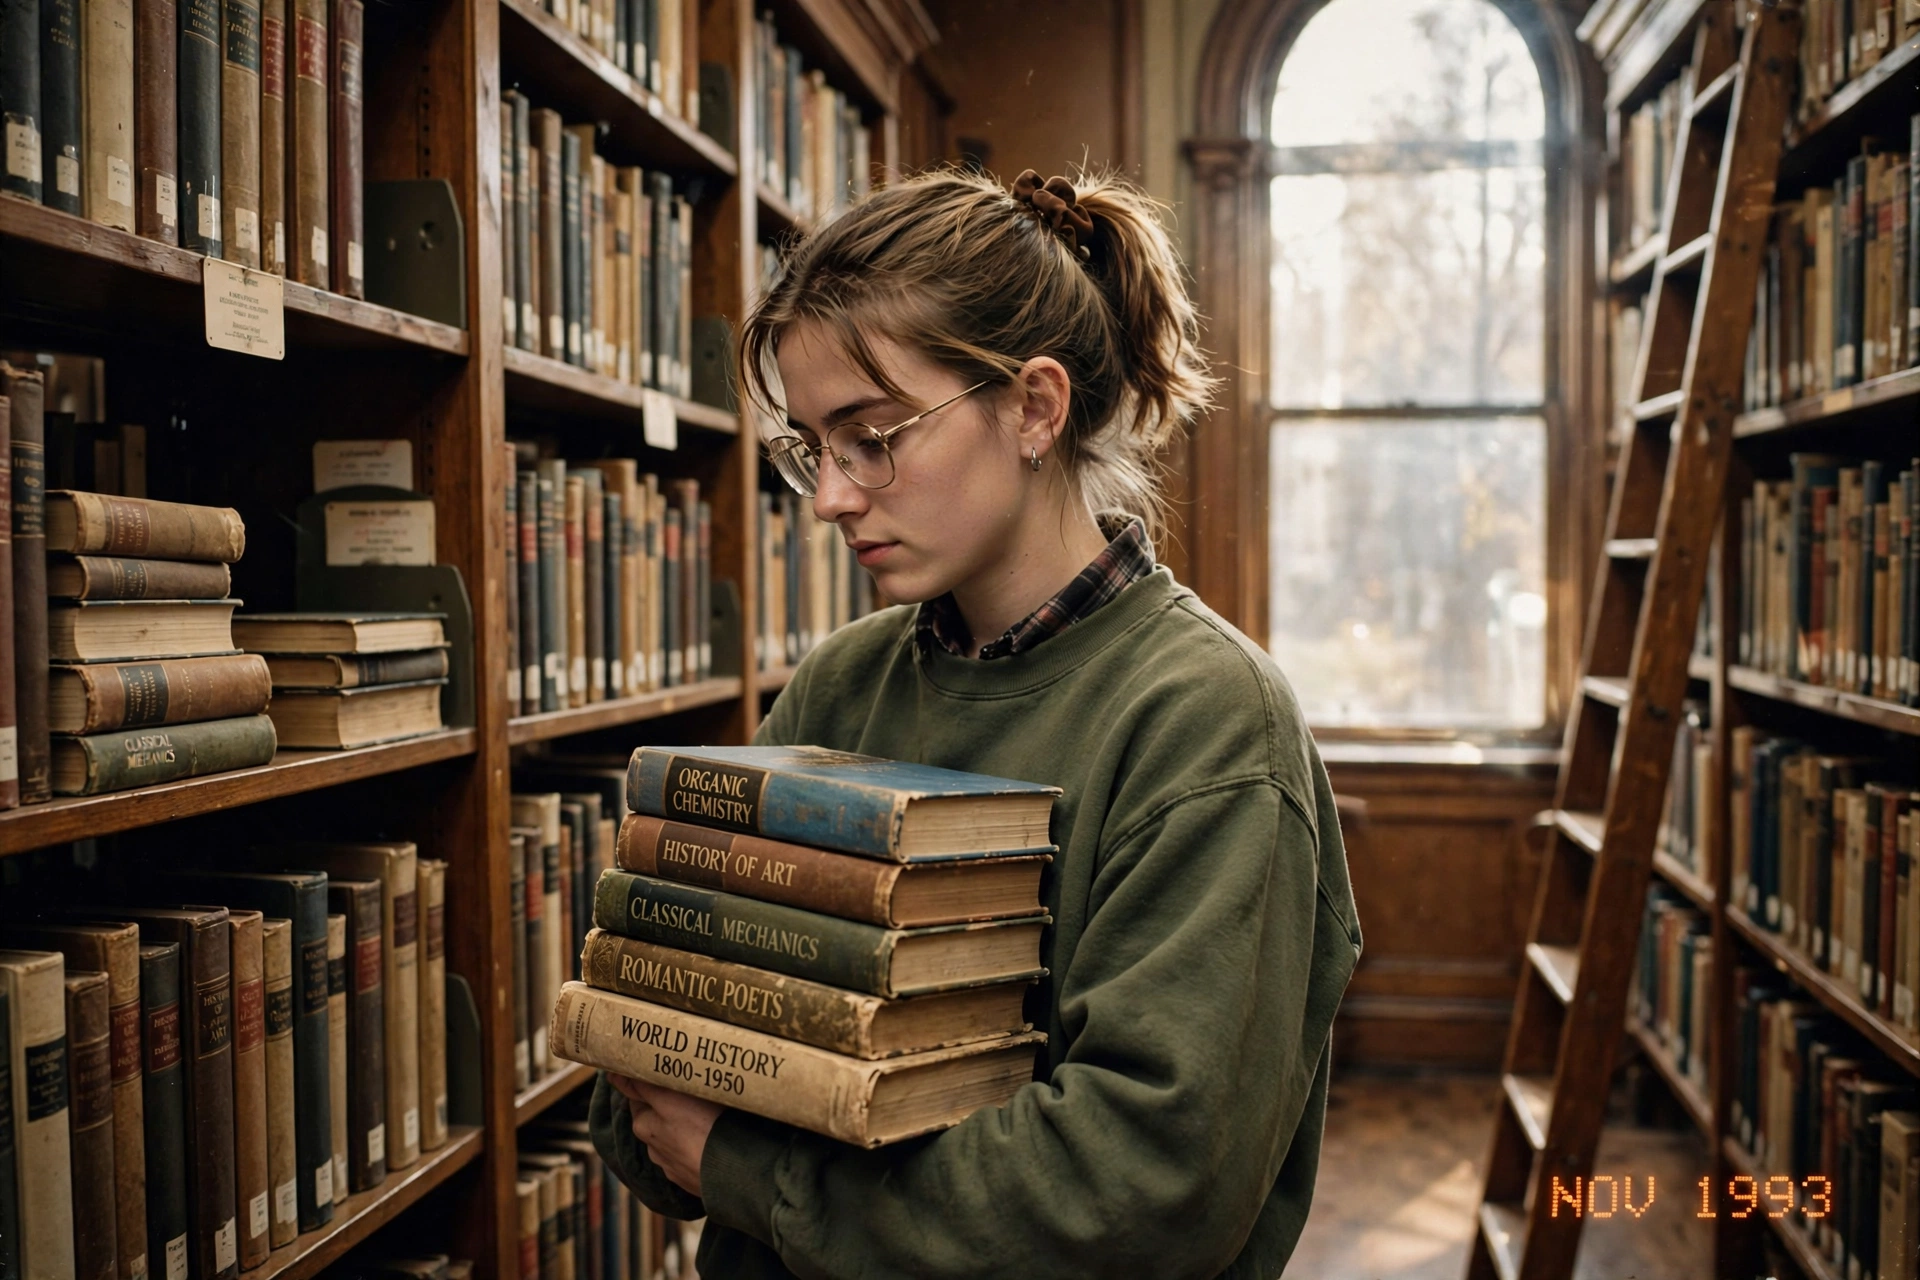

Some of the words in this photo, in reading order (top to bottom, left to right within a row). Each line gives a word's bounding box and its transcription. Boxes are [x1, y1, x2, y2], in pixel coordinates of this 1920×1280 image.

[679, 767, 748, 798] ORGANIC
[673, 790, 753, 824] CHEMISTRY
[662, 839, 731, 873] HISTORY
[735, 854, 758, 878] OF
[760, 859, 797, 886] ART
[630, 896, 713, 937] CLASSICAL
[720, 917, 819, 961] MECHANICS
[620, 954, 717, 1002] ROMANTIC
[721, 979, 784, 1020] POETS
[621, 1015, 688, 1053] WORLD
[694, 1036, 786, 1079] HISTORY
[653, 1053, 745, 1096] 1800-1950
